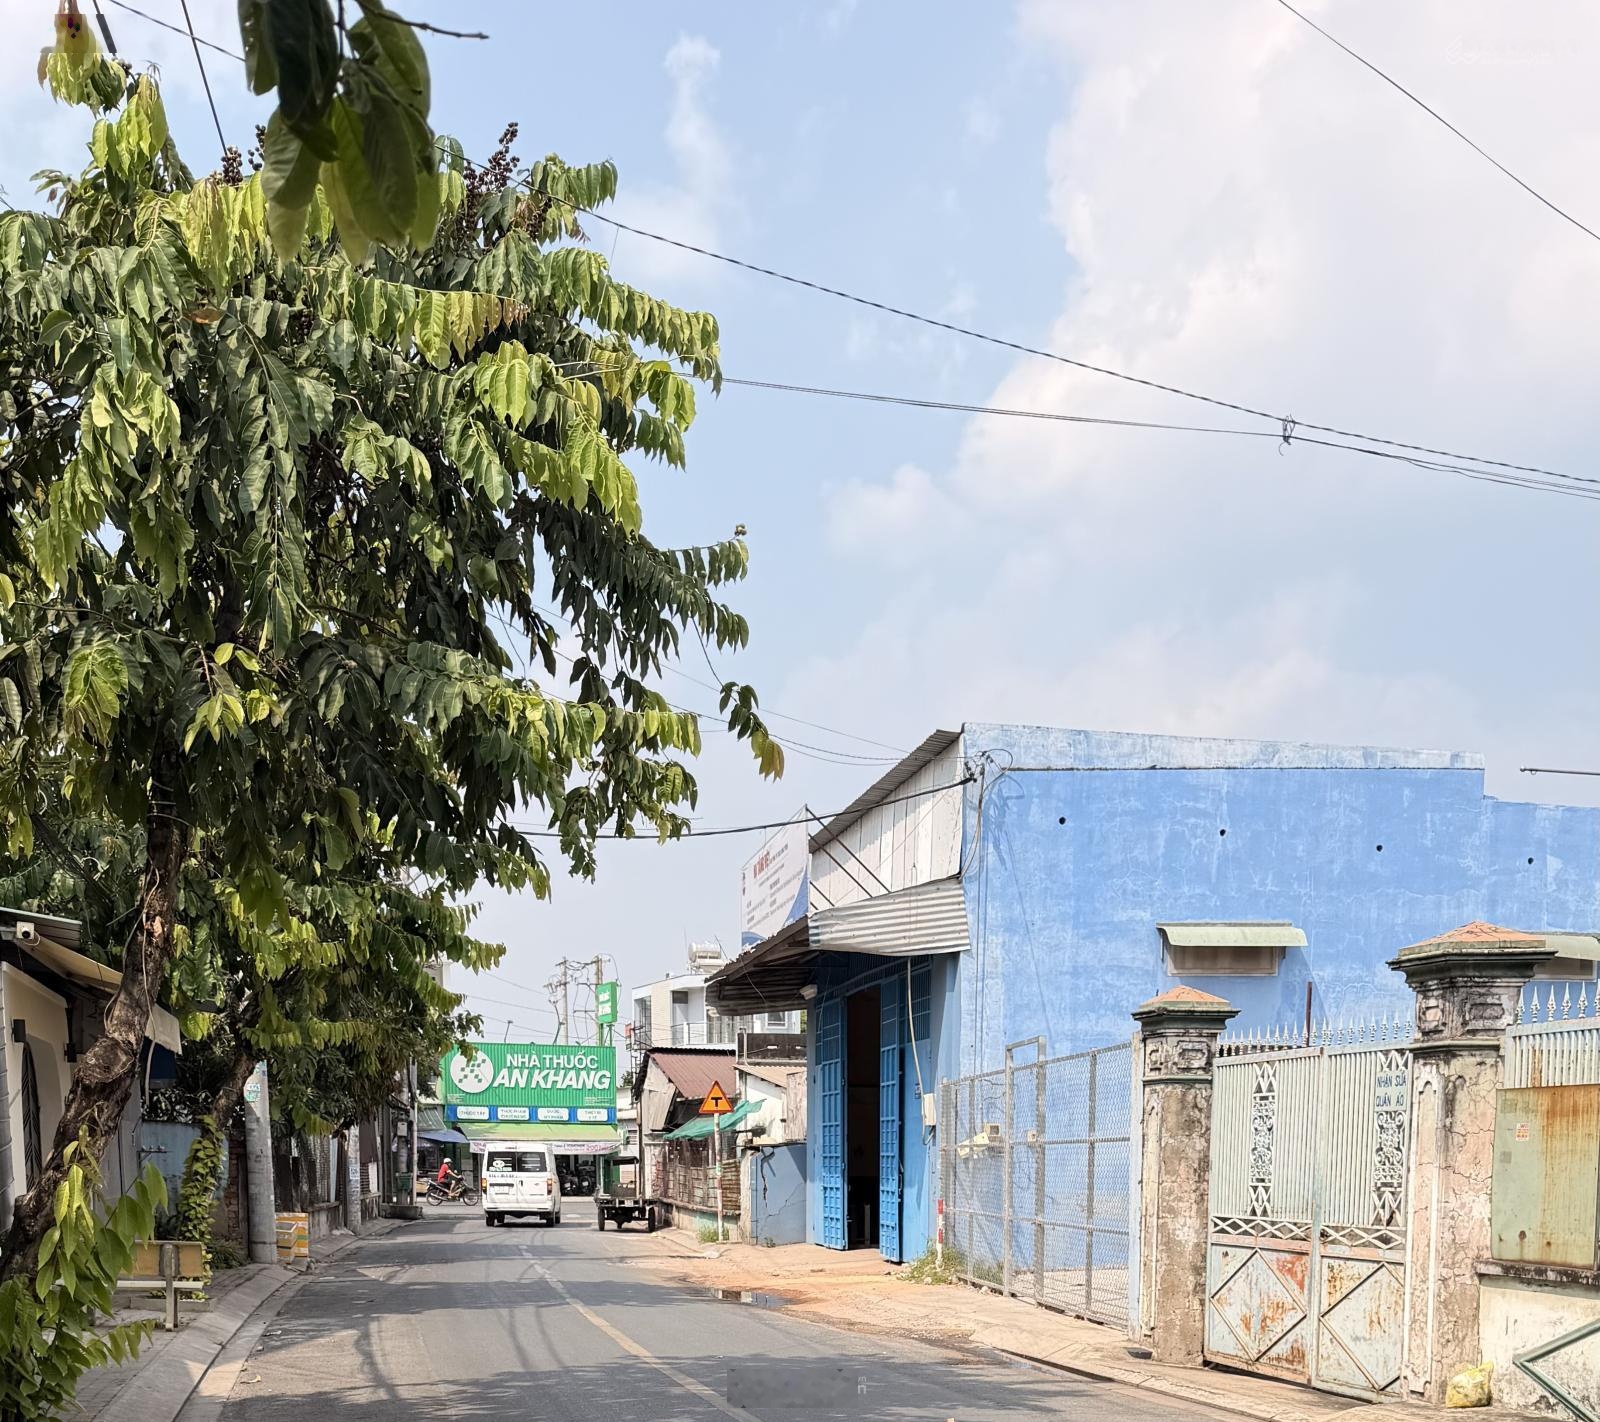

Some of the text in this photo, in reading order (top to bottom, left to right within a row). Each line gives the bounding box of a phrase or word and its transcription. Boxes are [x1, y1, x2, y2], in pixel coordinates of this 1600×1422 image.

[506, 1050, 598, 1069] NHÀ THUỐC
[492, 1068, 611, 1090] AN KHANG
